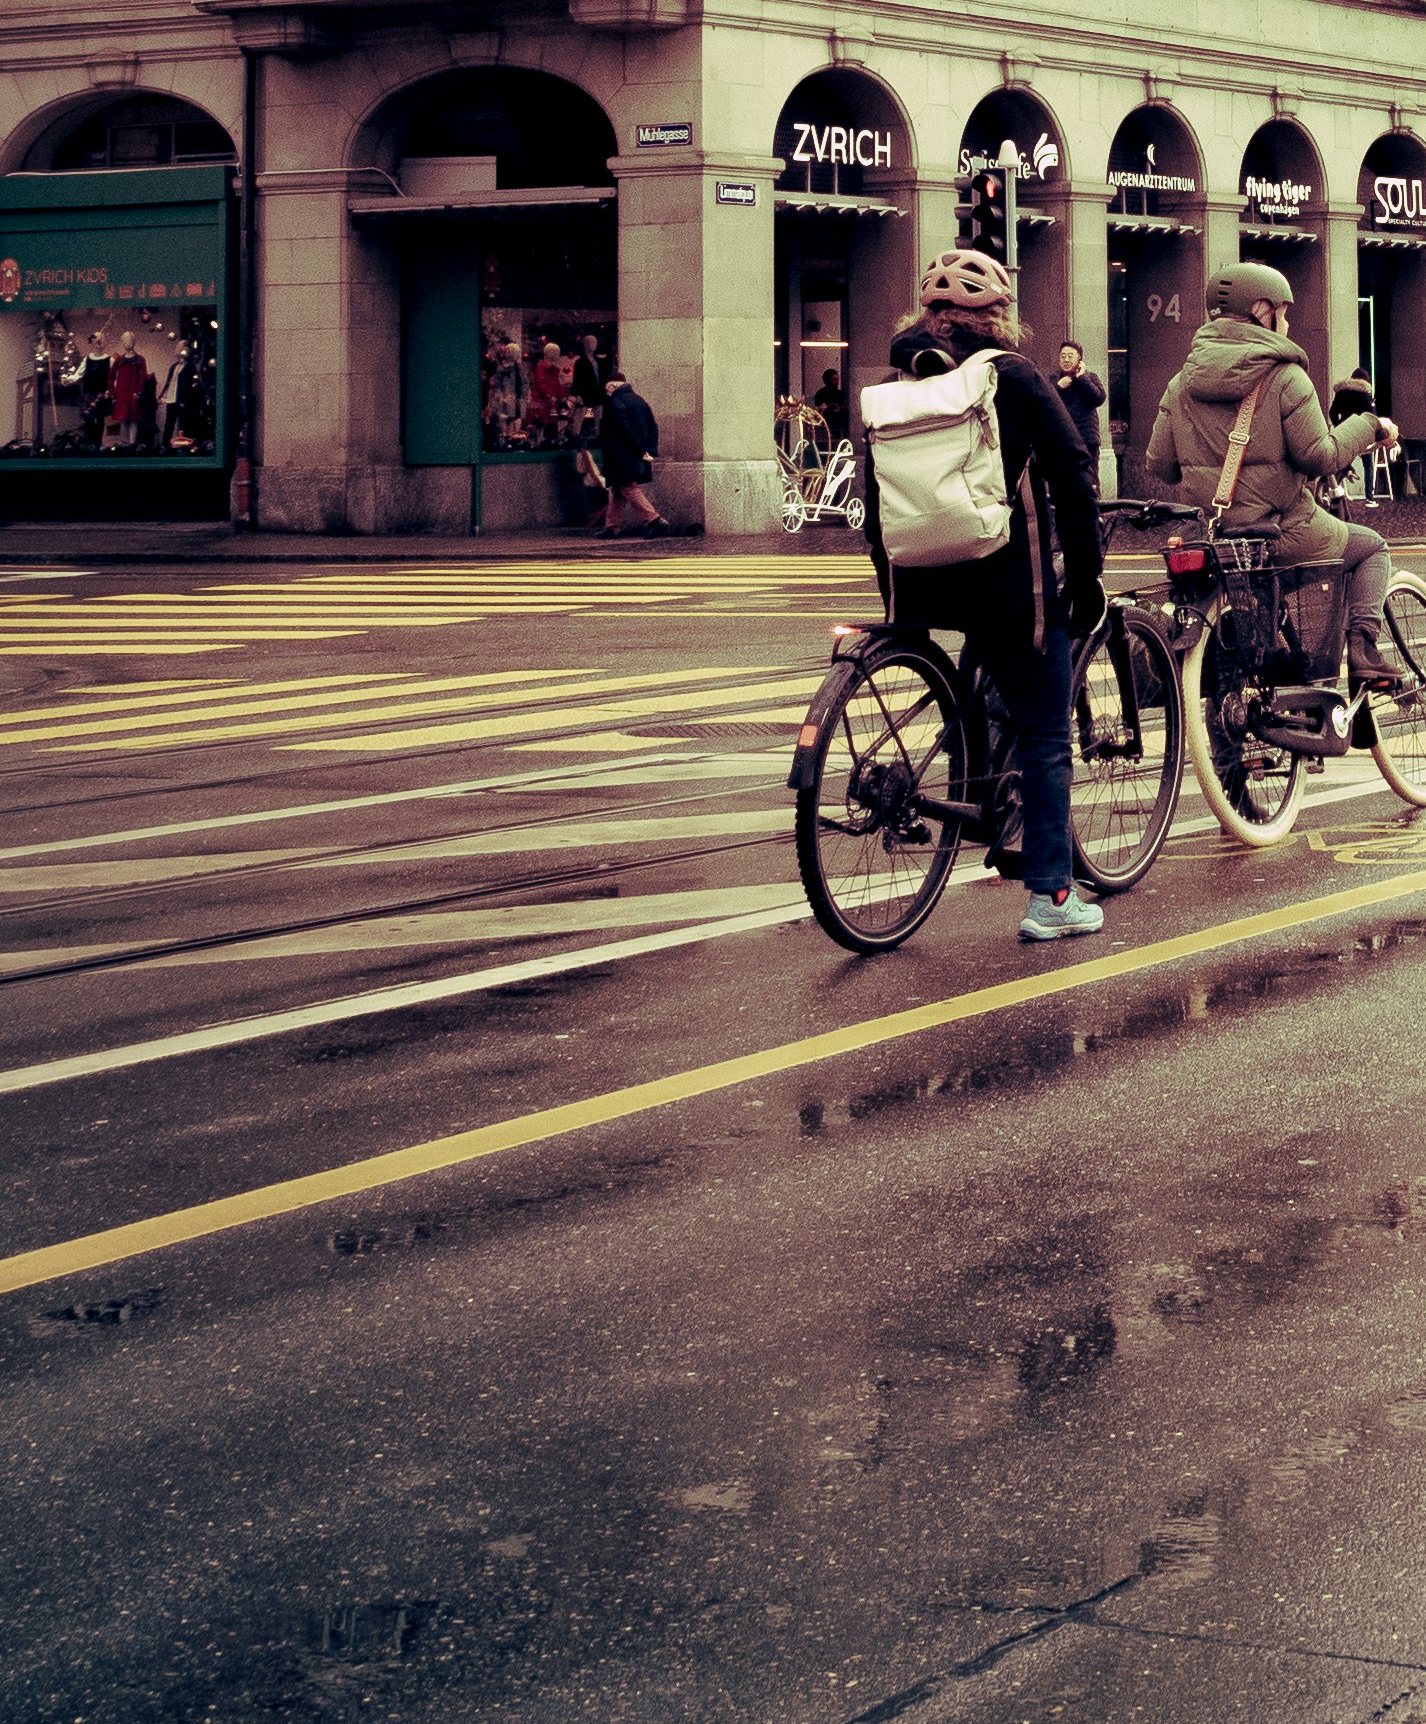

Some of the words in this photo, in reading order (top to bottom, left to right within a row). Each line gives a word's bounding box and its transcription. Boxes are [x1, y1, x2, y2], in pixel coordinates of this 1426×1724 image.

[639, 127, 689, 144] Mühlegasse
[792, 122, 891, 168] ZVRICH
[1107, 171, 1196, 192] AUGENARZTZENTRUM
[1245, 175, 1282, 203] flying
[1282, 179, 1312, 205] tiger
[1259, 202, 1300, 218] copenhagen
[76, 267, 108, 284] KIDS
[1146, 293, 1182, 324] 94
